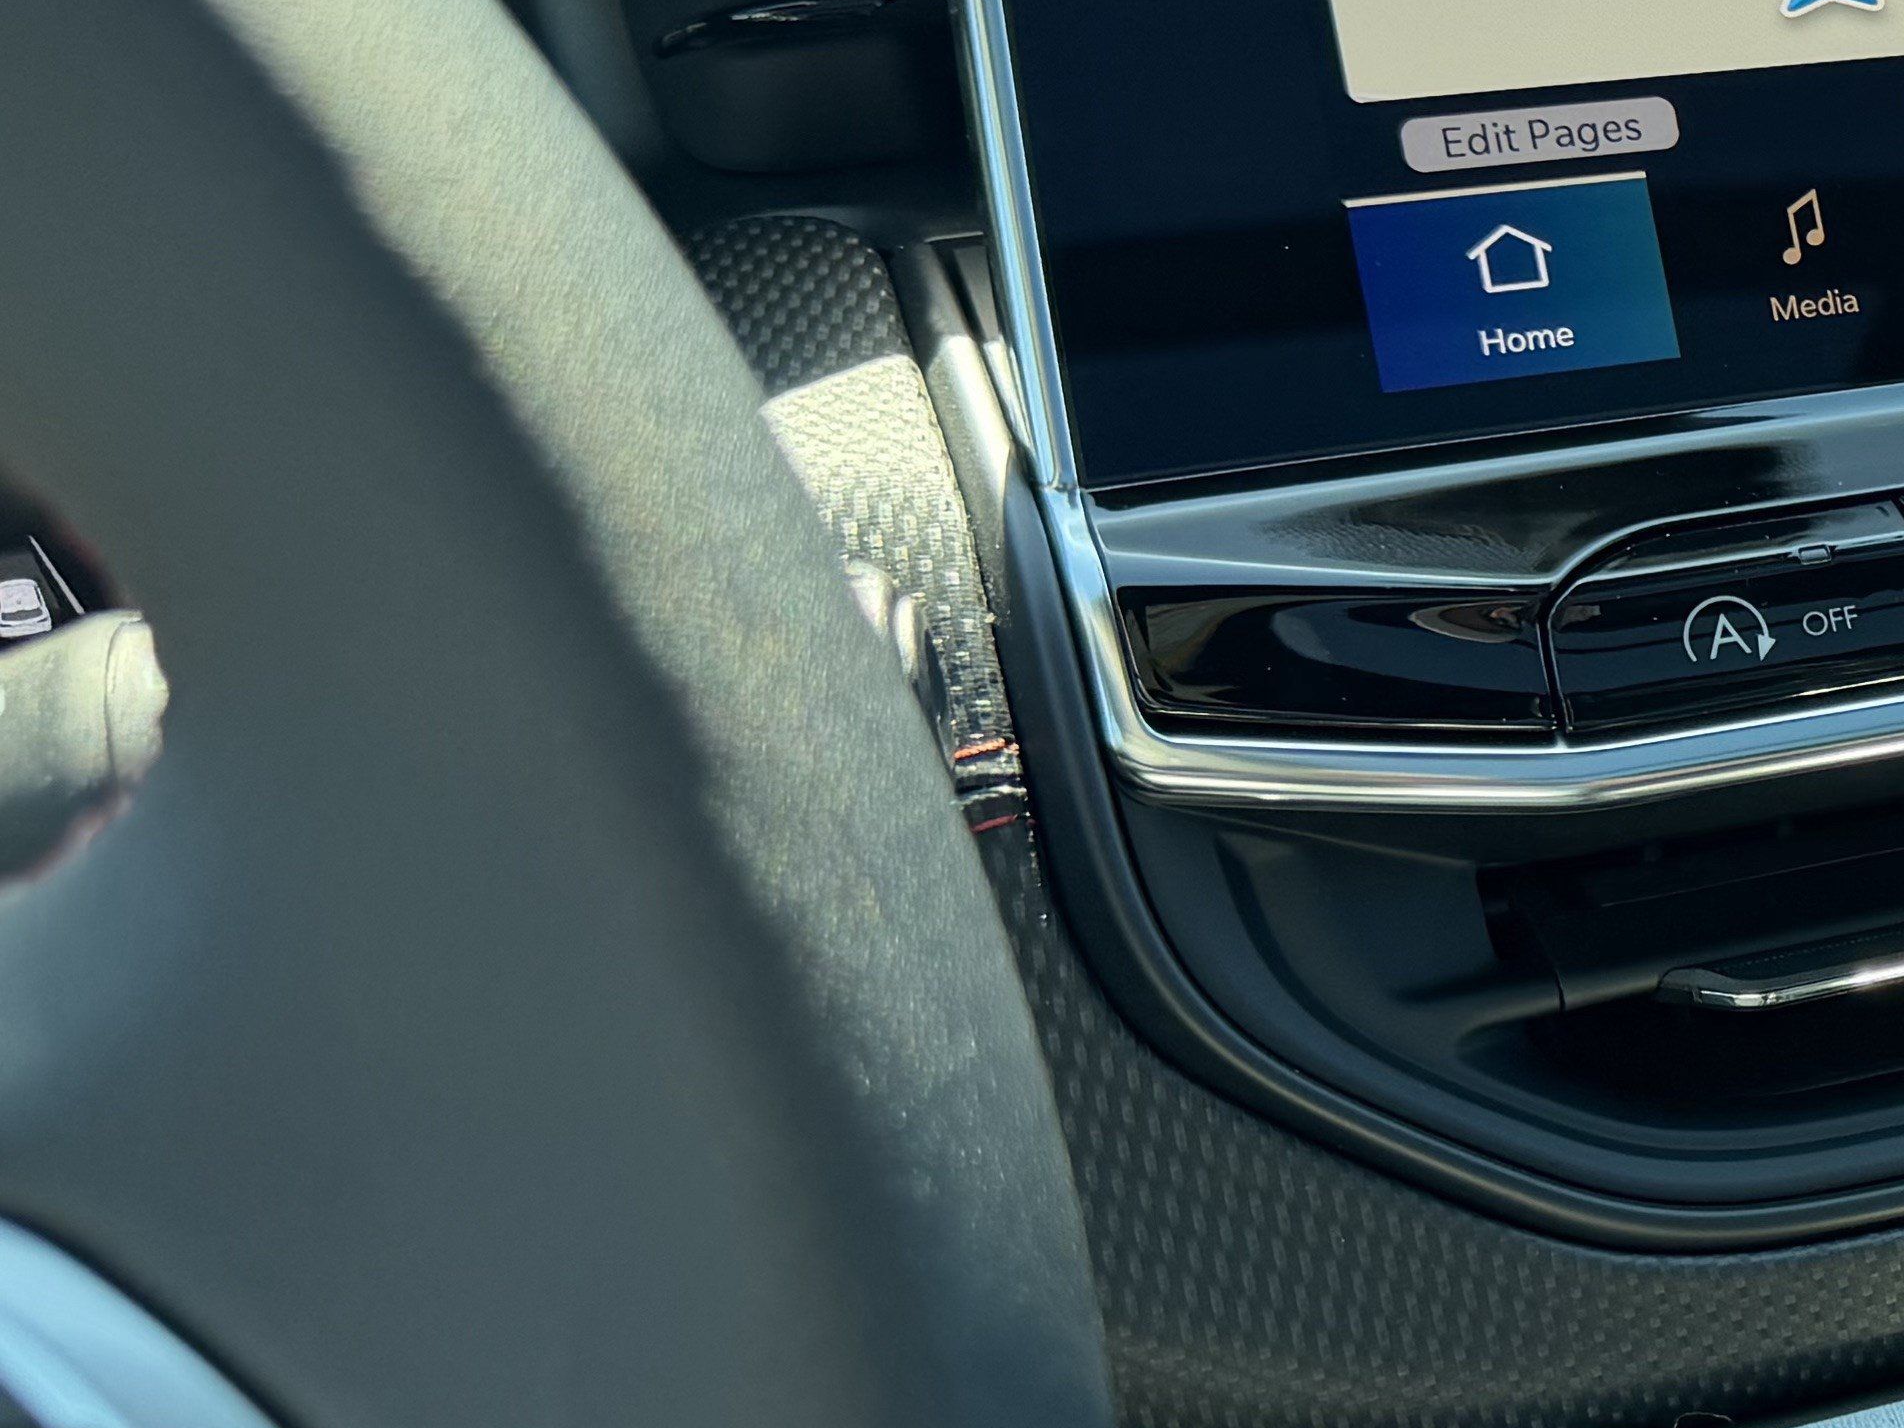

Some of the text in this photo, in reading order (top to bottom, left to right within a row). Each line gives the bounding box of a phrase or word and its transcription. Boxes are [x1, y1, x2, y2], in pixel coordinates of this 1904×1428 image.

[1443, 115, 1643, 160] Edit Pages
[1770, 289, 1860, 323] Media
[1480, 321, 1575, 358] Home
[1803, 605, 1859, 637] OFF
